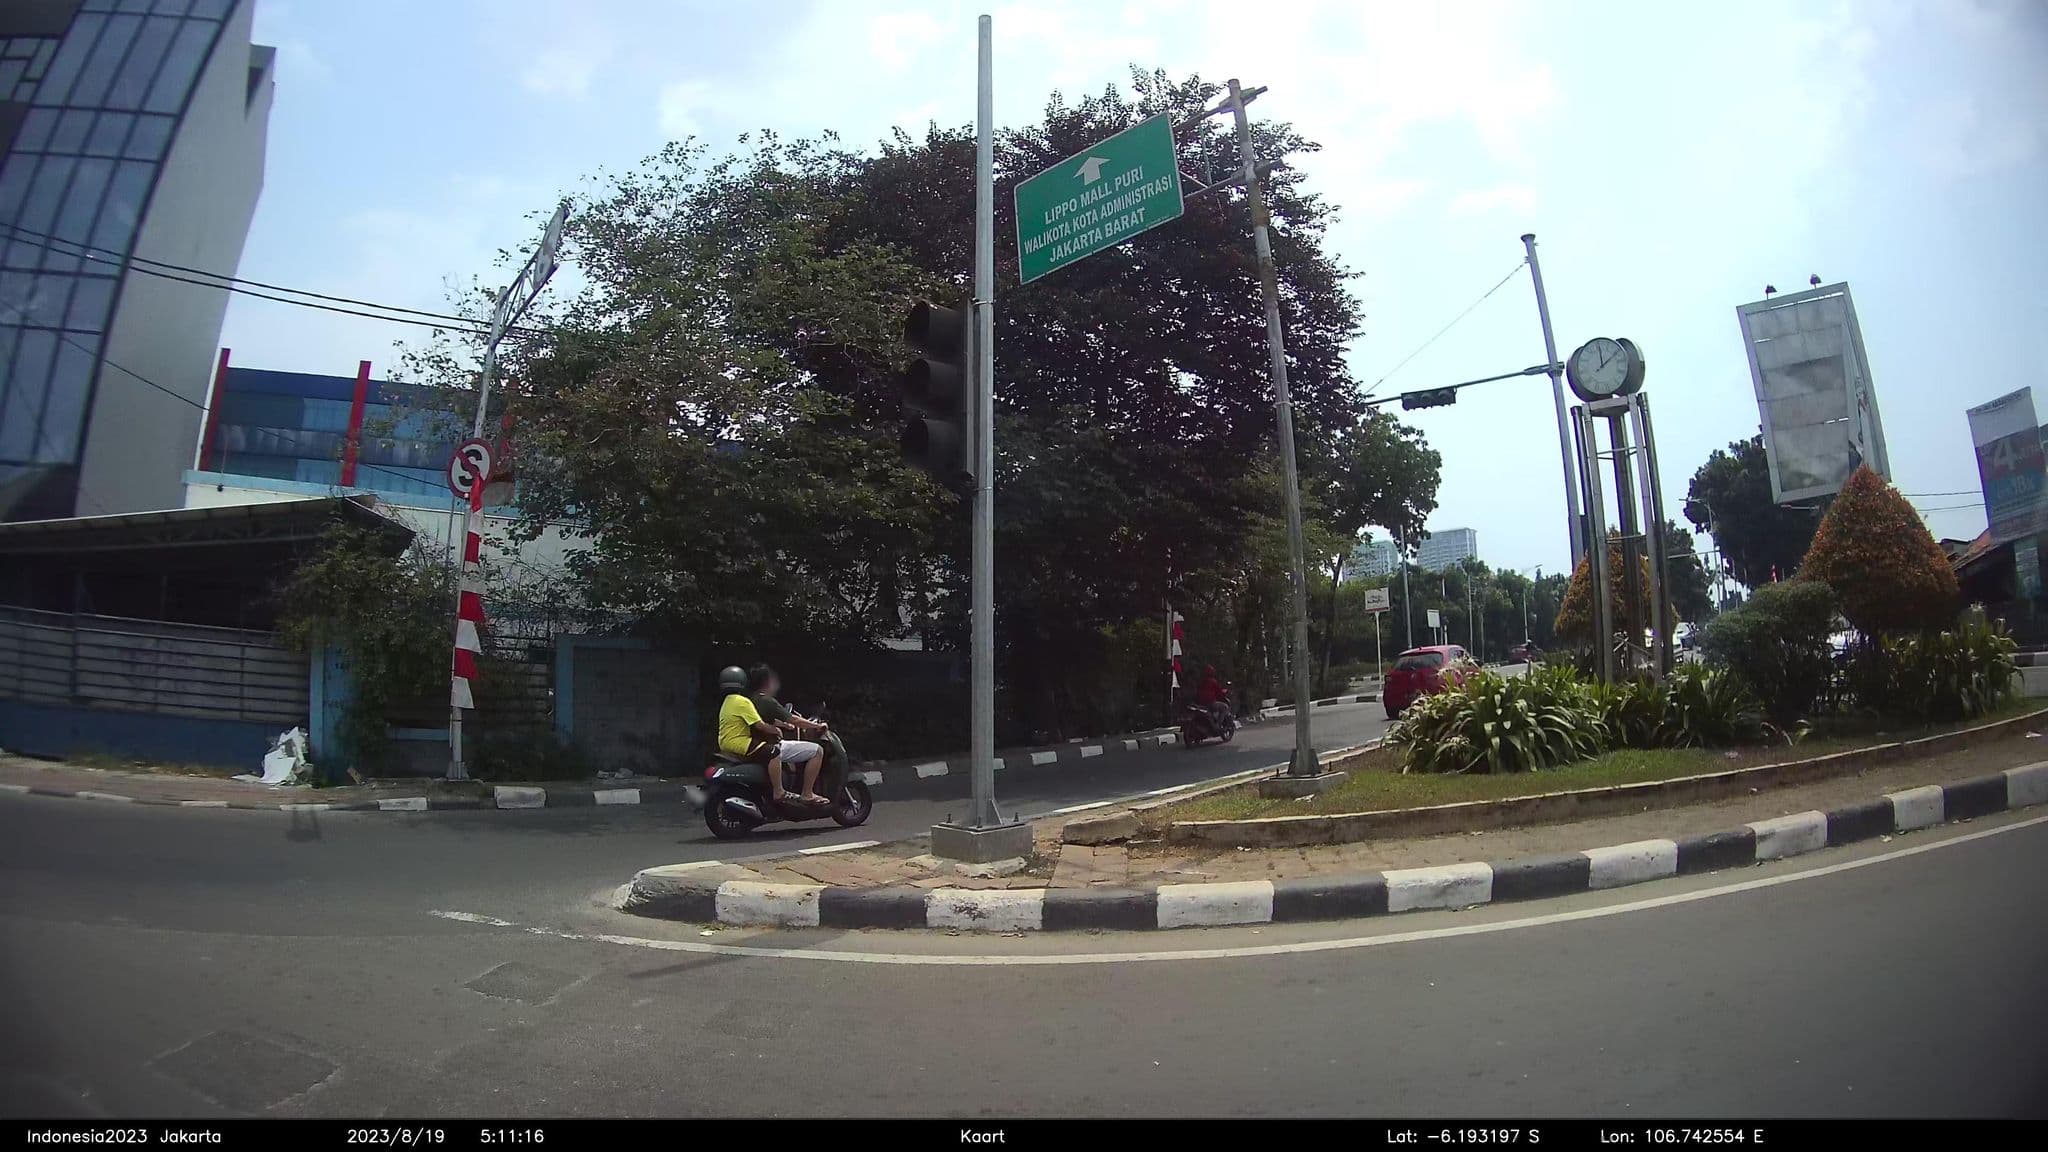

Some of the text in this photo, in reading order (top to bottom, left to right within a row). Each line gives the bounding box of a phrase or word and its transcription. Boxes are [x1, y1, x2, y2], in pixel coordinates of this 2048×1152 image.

[1024, 174, 1173, 255] WALIKOTA KOTA ADMINISTRASI
[1044, 166, 1143, 225] LIPPO MALL PURI
[1050, 207, 1146, 263] JAKARTA BARAT
[459, 449, 482, 486] S
